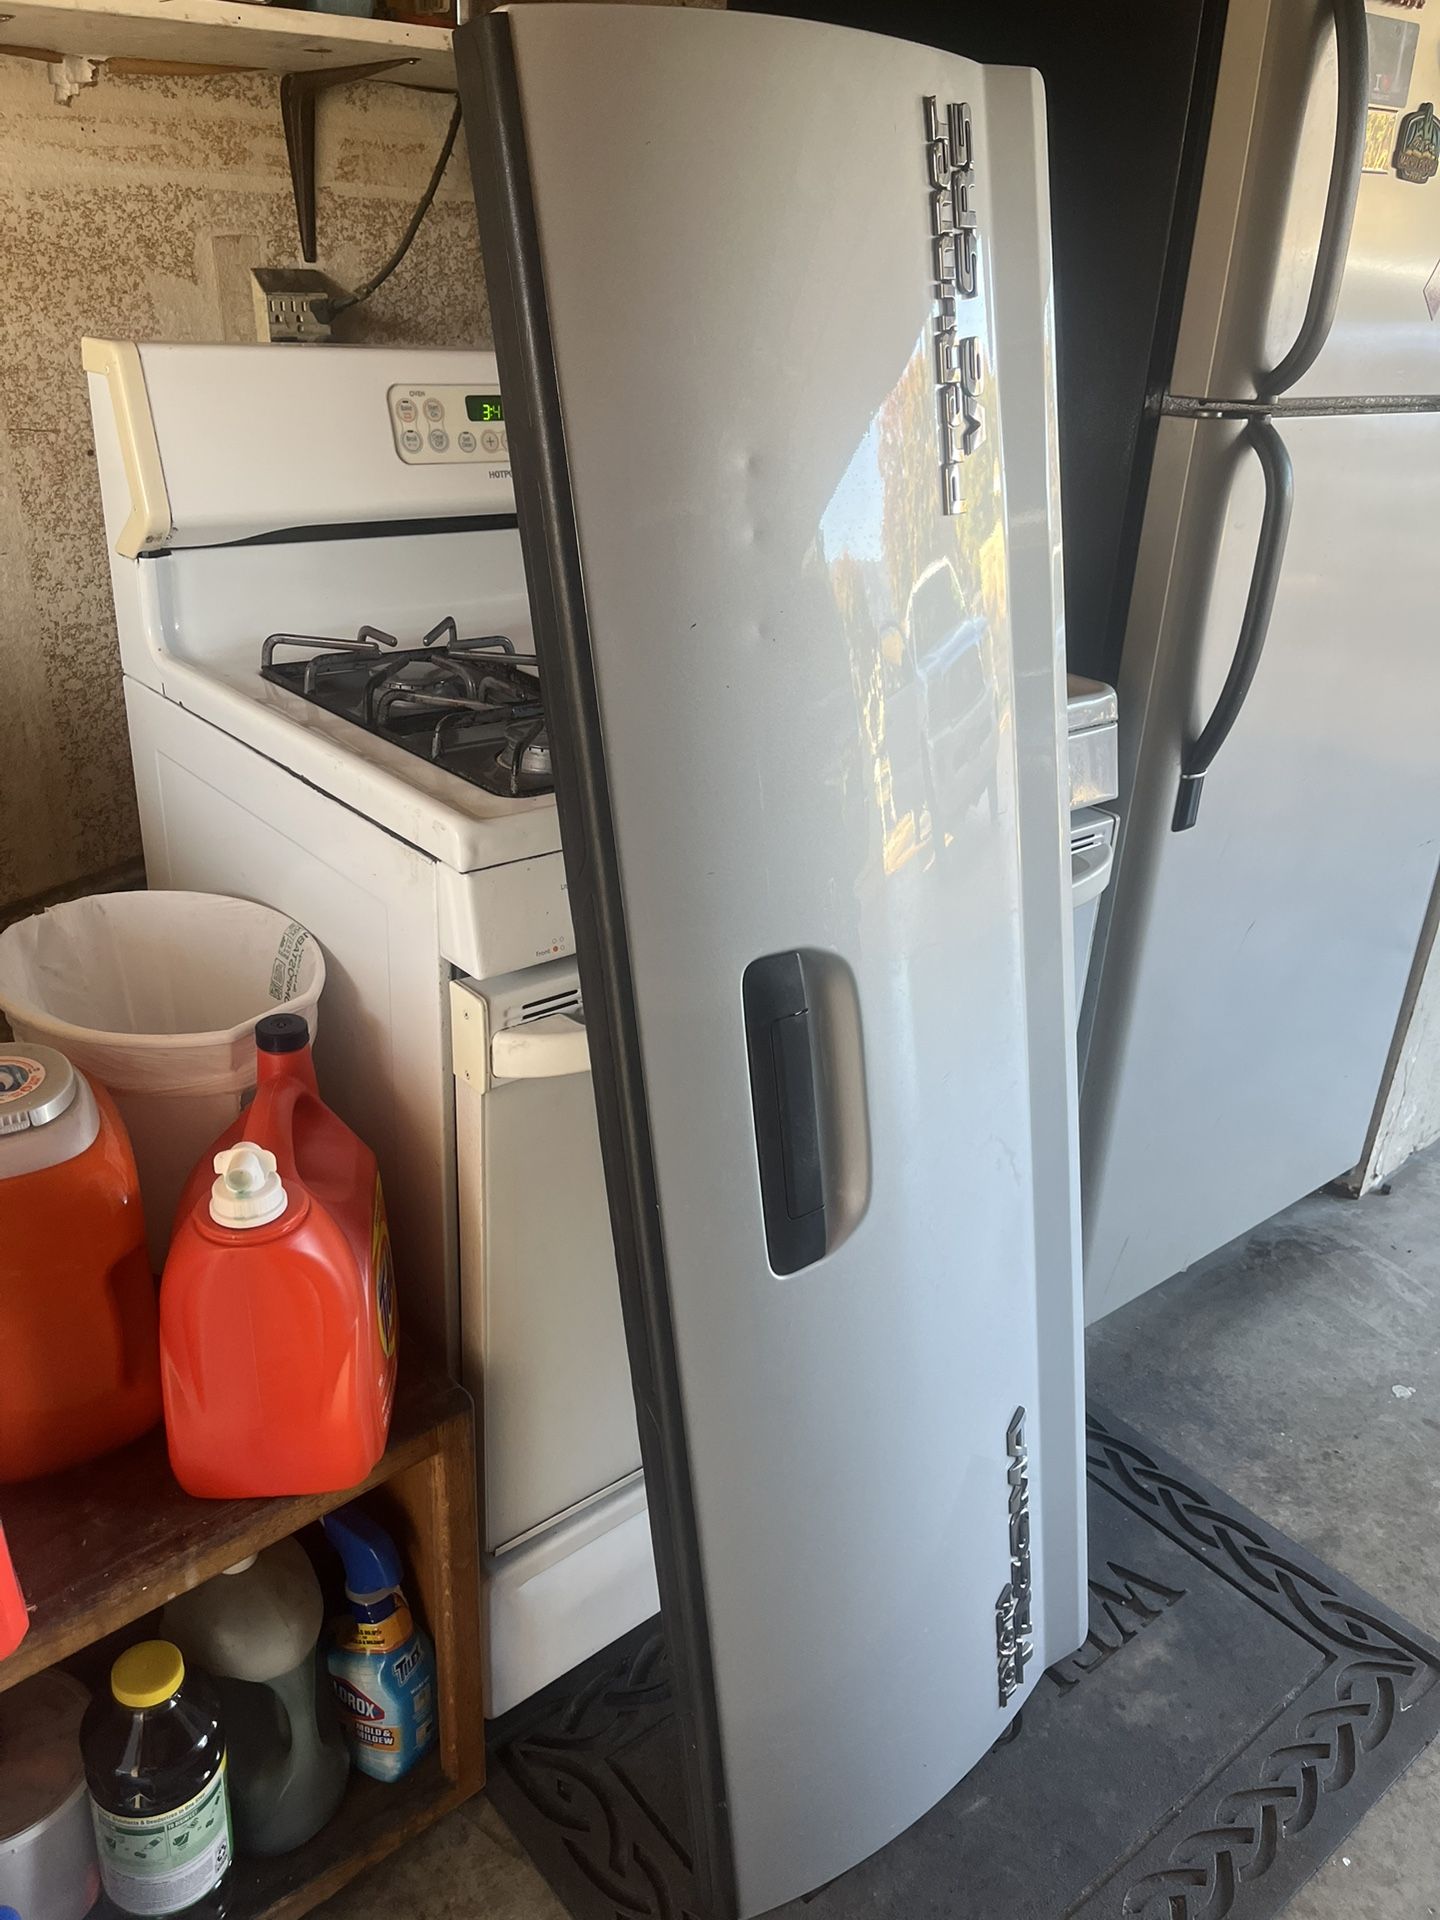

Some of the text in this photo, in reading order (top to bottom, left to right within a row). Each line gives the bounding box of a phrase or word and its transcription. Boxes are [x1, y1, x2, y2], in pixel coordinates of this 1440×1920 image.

[923, 95, 966, 516] PreRunner
[947, 102, 986, 456] V6 SR5
[1006, 1405, 1033, 1684] TACOMA
